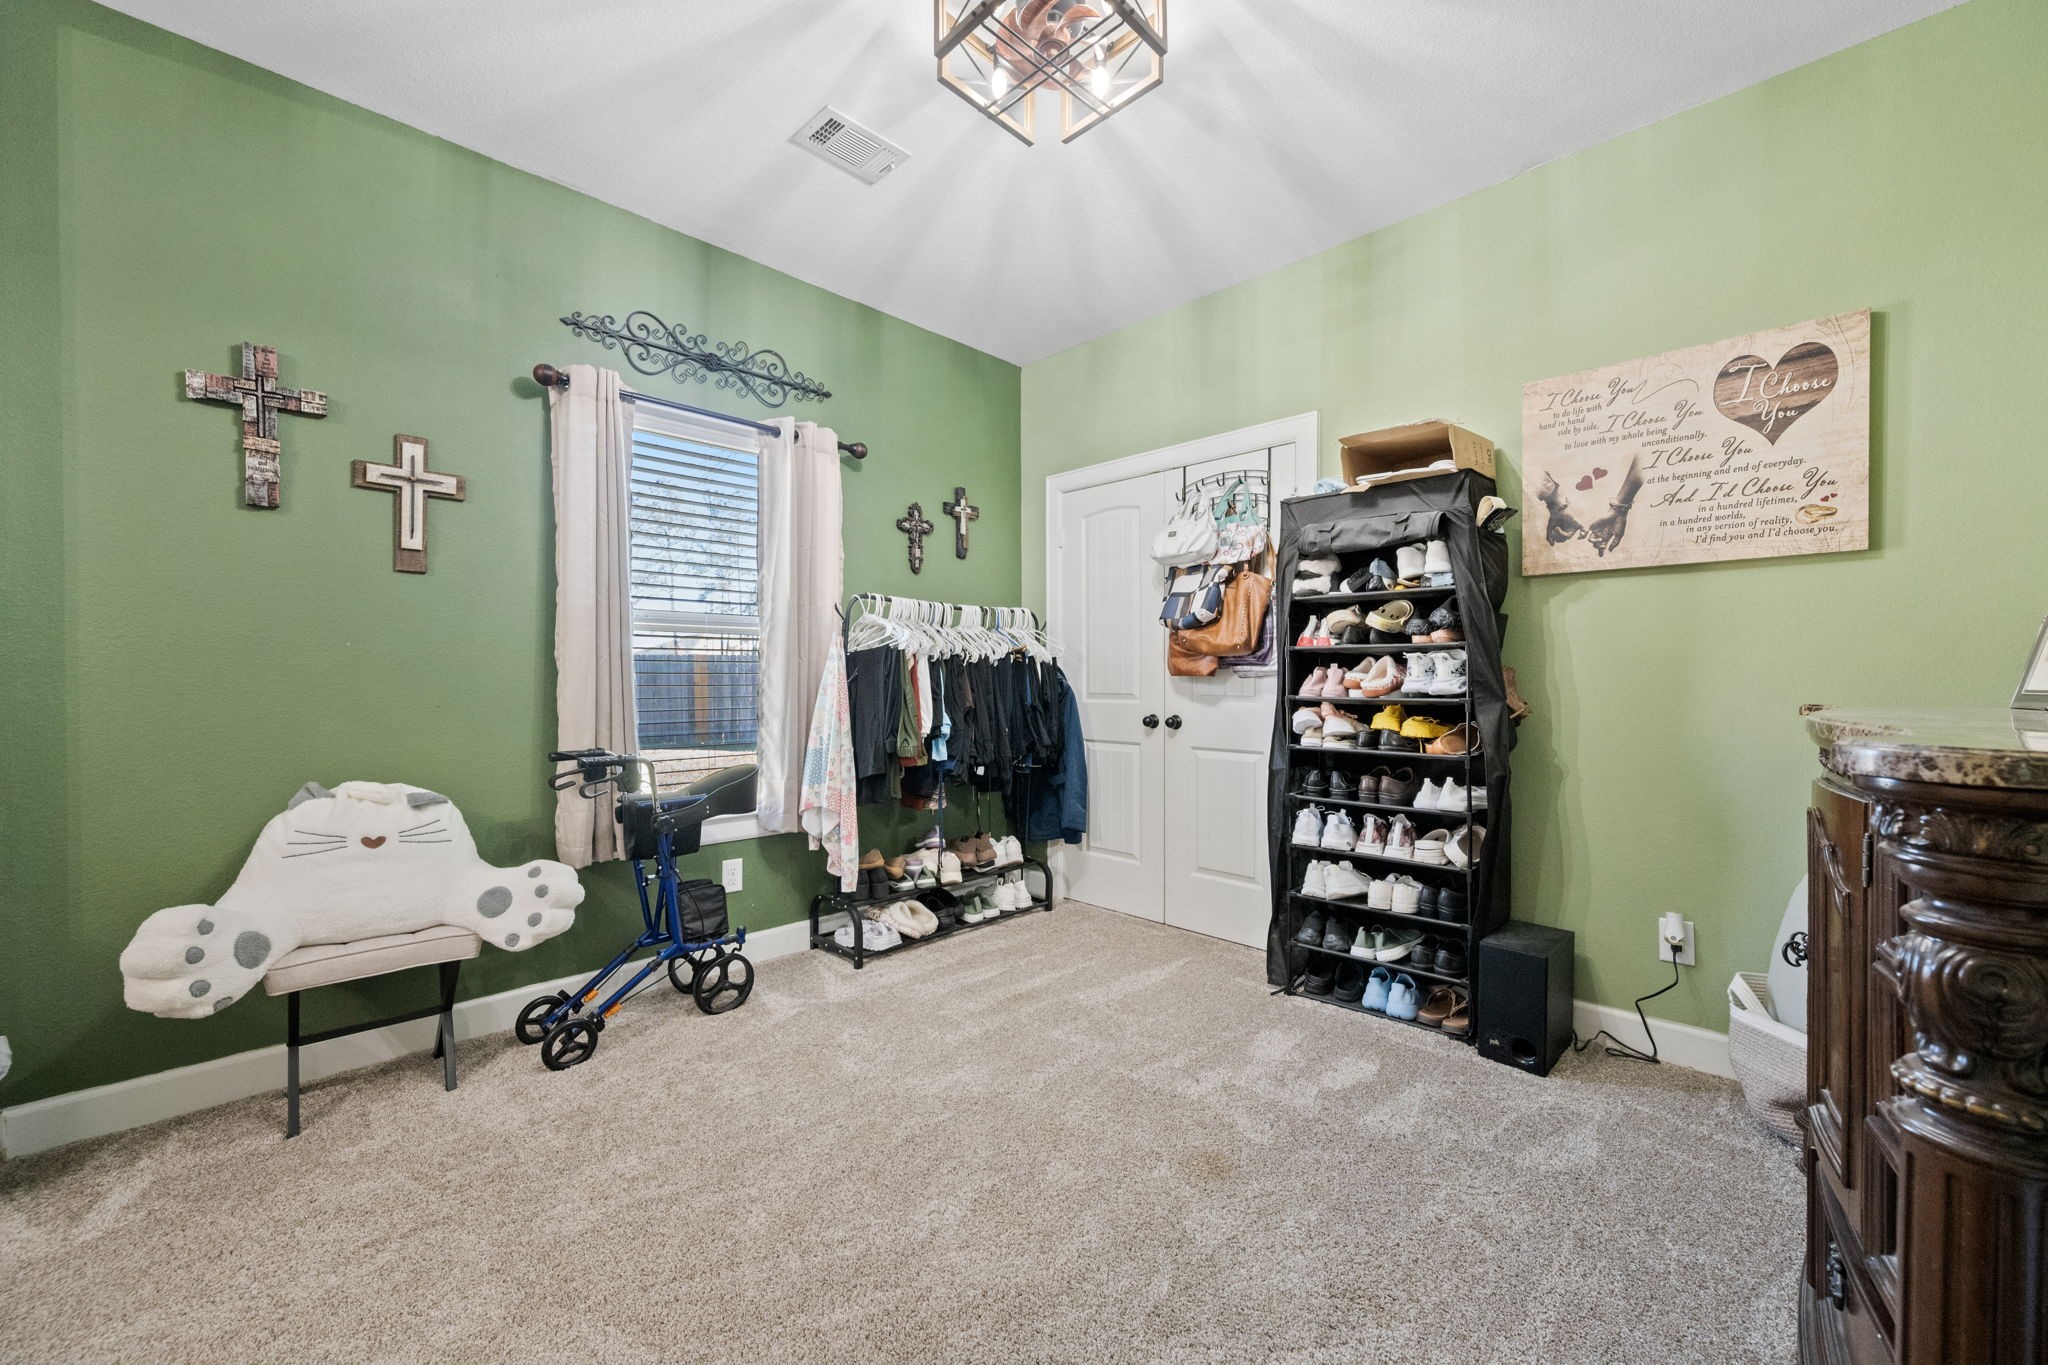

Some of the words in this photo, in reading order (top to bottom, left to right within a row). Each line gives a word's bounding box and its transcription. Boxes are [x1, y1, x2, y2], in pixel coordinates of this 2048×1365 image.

[1539, 392, 1562, 411] I
[1560, 389, 1601, 407] Choose
[1607, 377, 1638, 407] You
[1720, 363, 1768, 406] I
[1760, 371, 1832, 399] Choose
[1562, 409, 1571, 418] do
[1572, 406, 1584, 418] life
[1586, 403, 1602, 412] with
[1599, 414, 1624, 434] I
[1622, 410, 1667, 429] Choose
[1672, 399, 1704, 430] You
[1753, 398, 1799, 434] You
[1539, 422, 1557, 430] hand
[1567, 416, 1585, 425] hand
[1557, 428, 1571, 436] side
[1573, 425, 1581, 434] by
[1583, 423, 1599, 432] side.
[1574, 440, 1588, 449] love
[1590, 437, 1607, 446] with
[1608, 436, 1620, 444] my
[1622, 431, 1644, 441] whole
[1646, 427, 1668, 437] being
[1641, 431, 1707, 448] unconditionally.
[1642, 449, 1669, 470] I
[1666, 446, 1714, 466] Choose
[1720, 436, 1754, 467] You
[1647, 477, 1656, 485] at
[1657, 473, 1670, 483] the
[1671, 469, 1712, 483] beginning
[1714, 465, 1731, 476] and
[1733, 463, 1749, 473] end
[1751, 460, 1764, 473] of
[1764, 456, 1807, 471] everyday.
[1650, 484, 1699, 507] And
[1699, 481, 1739, 502] I'd
[1741, 477, 1795, 497] Choose
[1800, 466, 1838, 500] You
[1698, 504, 1708, 513] in
[1717, 500, 1753, 511] hundred
[1756, 495, 1798, 508] lifetimes,
[1659, 519, 1668, 527] in
[1677, 514, 1712, 525] hundred
[1714, 511, 1747, 522] worlds,
[1696, 525, 1712, 534] any
[1715, 520, 1746, 531] version
[1748, 518, 1758, 529] of
[1760, 515, 1793, 527] reality,
[1695, 534, 1708, 544] I'd
[1708, 533, 1727, 545] find
[1729, 532, 1745, 543] you
[1747, 529, 1765, 539] and
[1767, 527, 1781, 537] I'd
[1783, 526, 1815, 536] choose
[1814, 526, 1838, 538] you.
